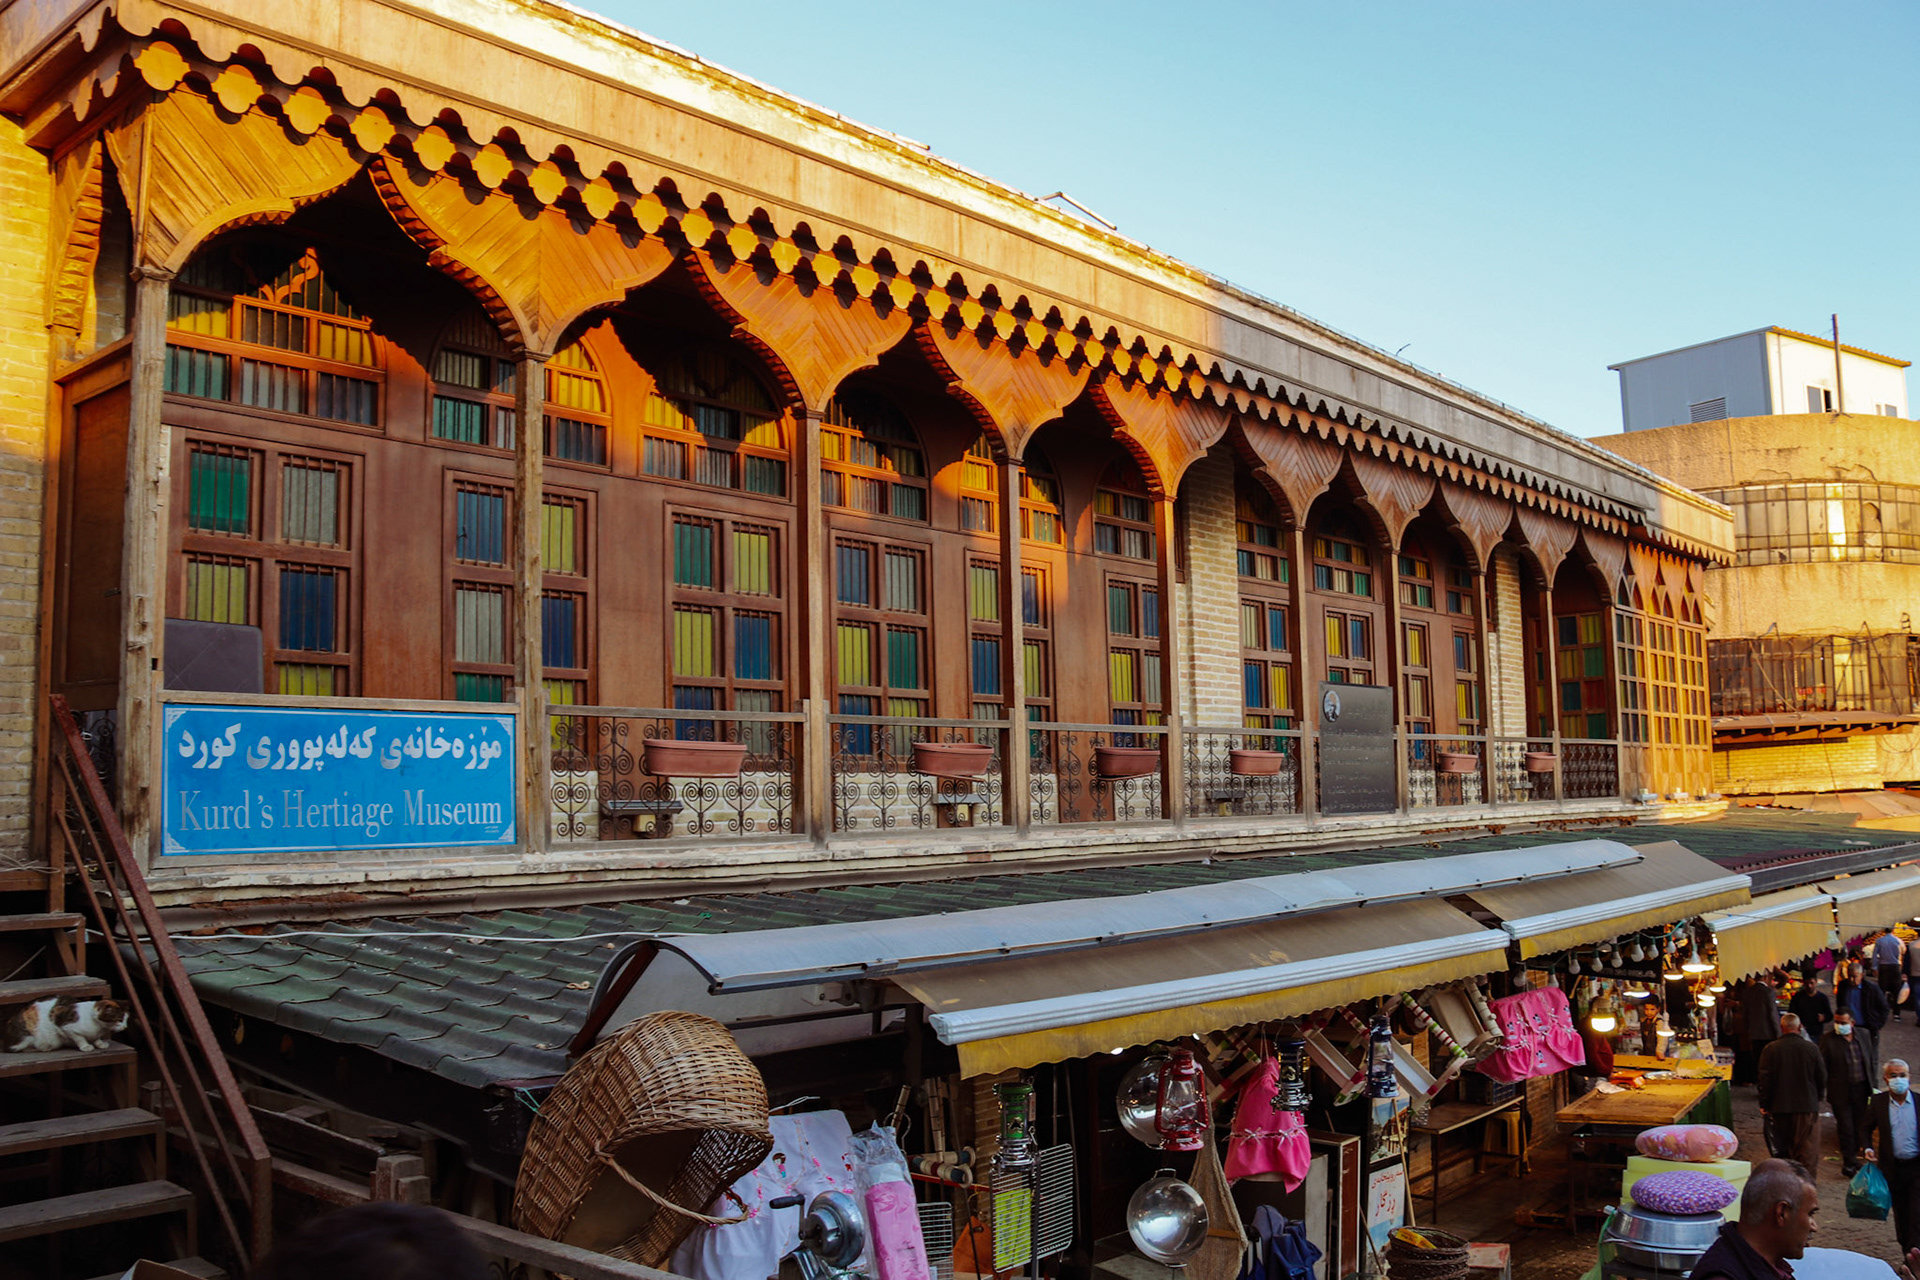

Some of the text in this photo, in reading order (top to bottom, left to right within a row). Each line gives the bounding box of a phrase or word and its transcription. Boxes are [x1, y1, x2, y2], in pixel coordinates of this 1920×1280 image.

[179, 722, 502, 772] مۆزەخانەی کەلەپووری کورد
[179, 789, 502, 838] Kurd's Hertiage Museum
